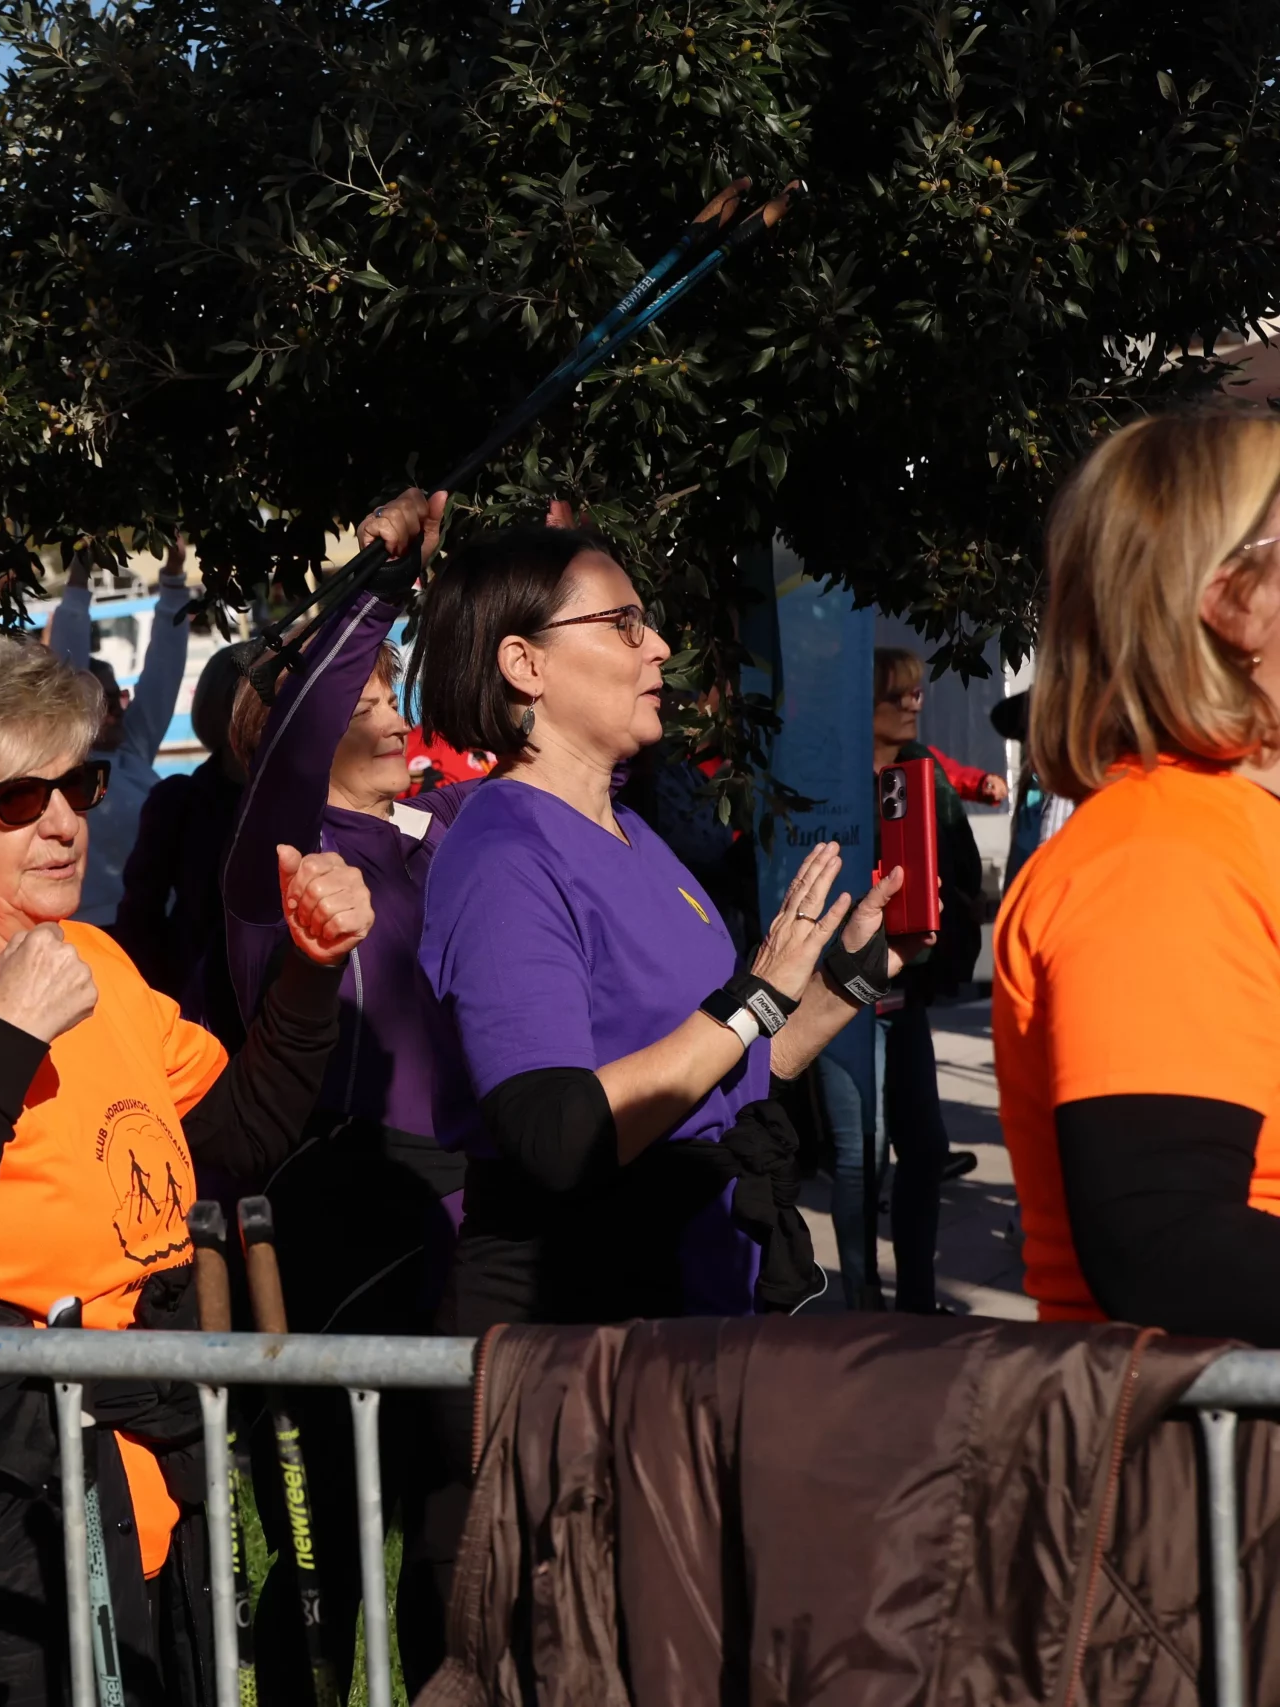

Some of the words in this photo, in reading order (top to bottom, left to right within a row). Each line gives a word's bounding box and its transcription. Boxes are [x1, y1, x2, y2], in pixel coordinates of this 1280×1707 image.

[617, 275, 656, 314] NEWFEEL
[757, 995, 782, 1028] newfeel
[96, 1127, 108, 1162] KLUB
[104, 1098, 151, 1122] NORDIJSKOG
